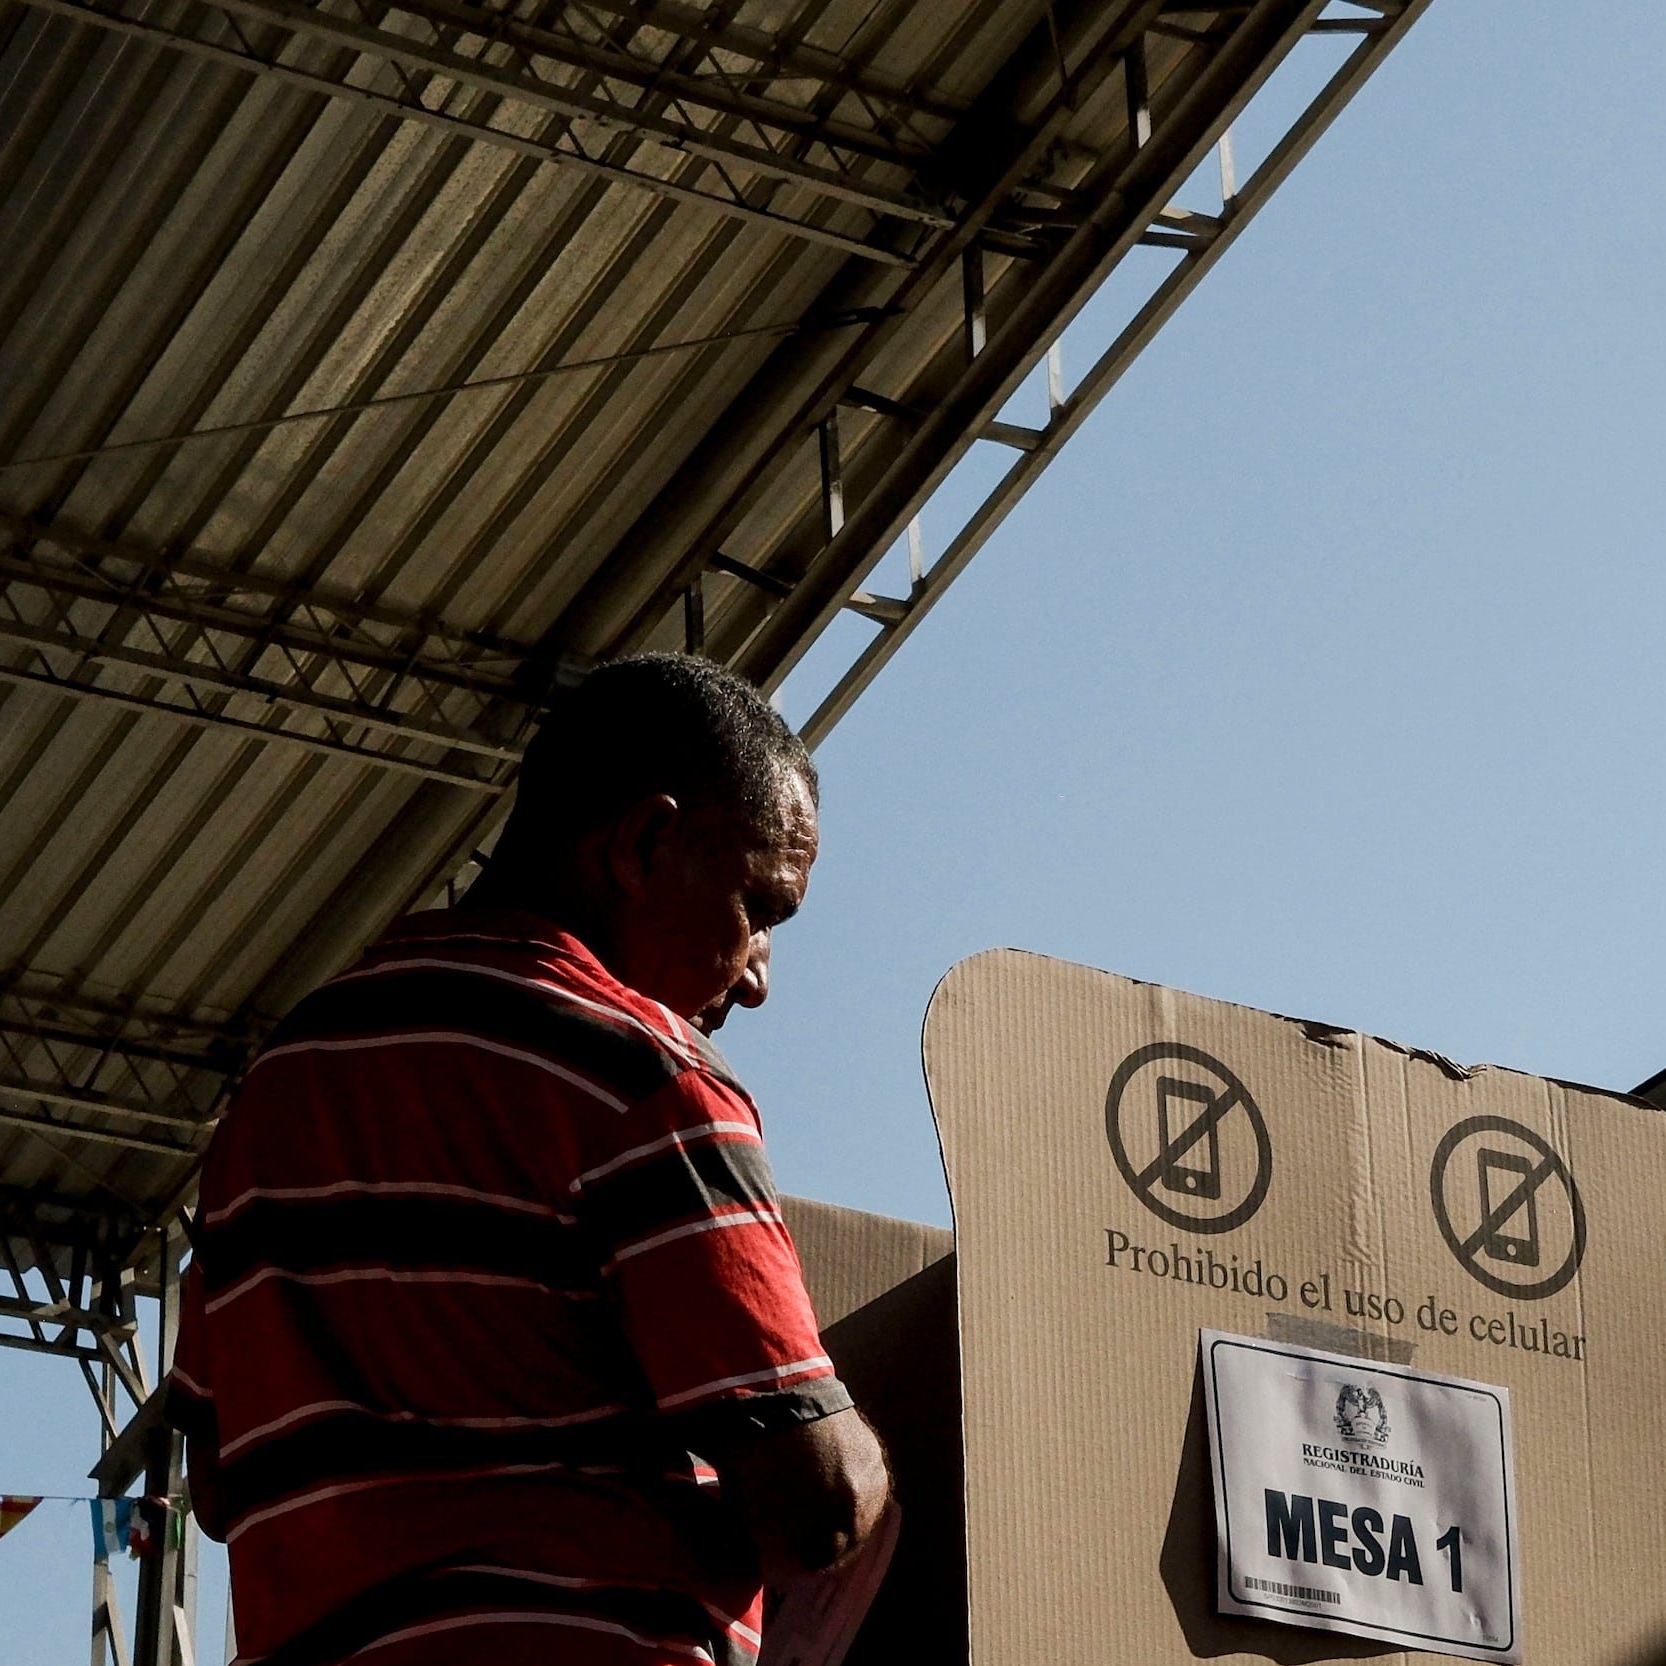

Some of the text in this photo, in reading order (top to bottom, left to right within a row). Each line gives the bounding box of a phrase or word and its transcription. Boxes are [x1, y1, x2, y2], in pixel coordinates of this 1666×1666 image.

[1103, 1228, 1587, 1361] Prohibido el uso de celular
[1302, 1443, 1425, 1478] REGISTRADURÍA
[1303, 1458, 1425, 1488] NACIONAL DEL ESTADO CIVIL
[1264, 1488, 1463, 1593] MESA 1
